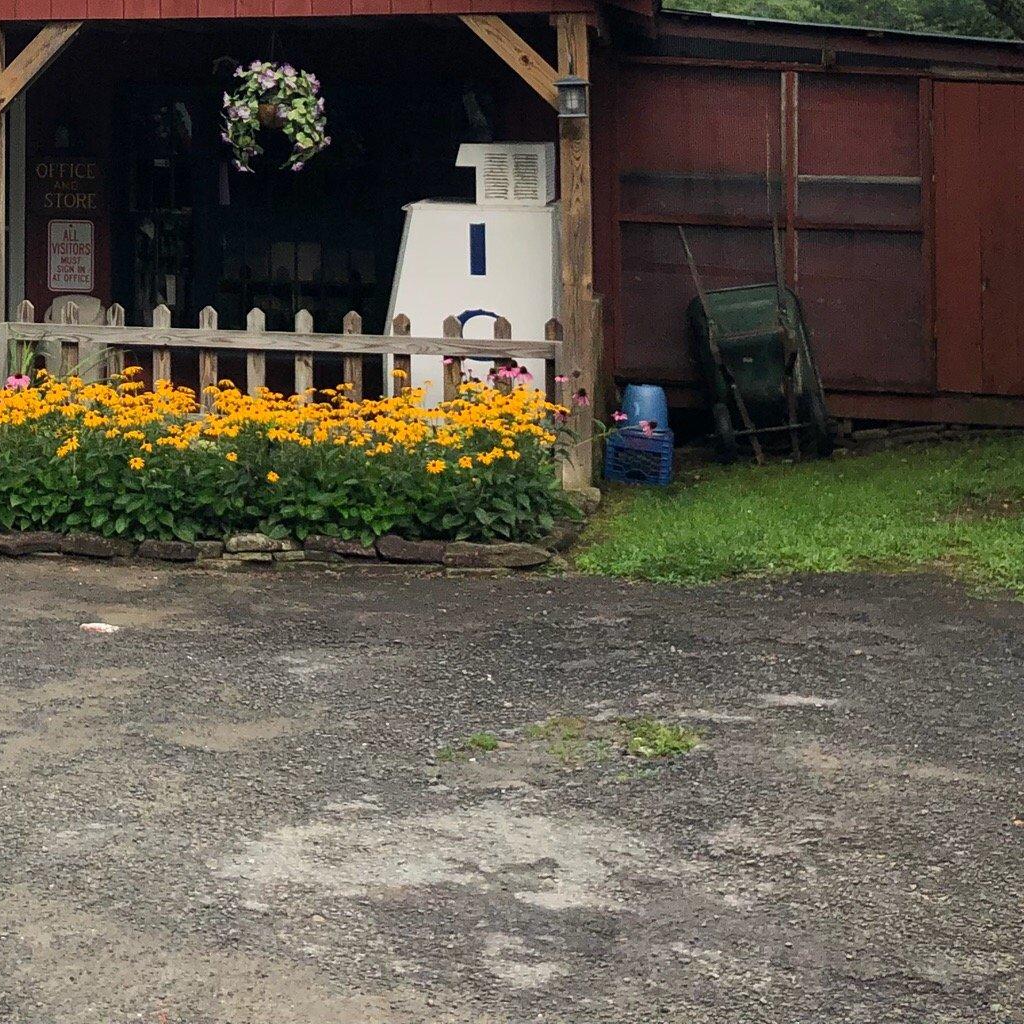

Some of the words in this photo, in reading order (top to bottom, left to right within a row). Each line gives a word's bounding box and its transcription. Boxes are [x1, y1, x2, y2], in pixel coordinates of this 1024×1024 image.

[36, 163, 95, 180] OFFICE
[45, 193, 97, 209] STORE
[63, 229, 78, 242] ALL
[52, 243, 91, 255] VISITORS
[61, 257, 81, 265] MUST
[57, 265, 74, 273] SIGN
[76, 265, 85, 273] IN
[52, 275, 60, 283] AT
[64, 275, 90, 283] OFFICE
